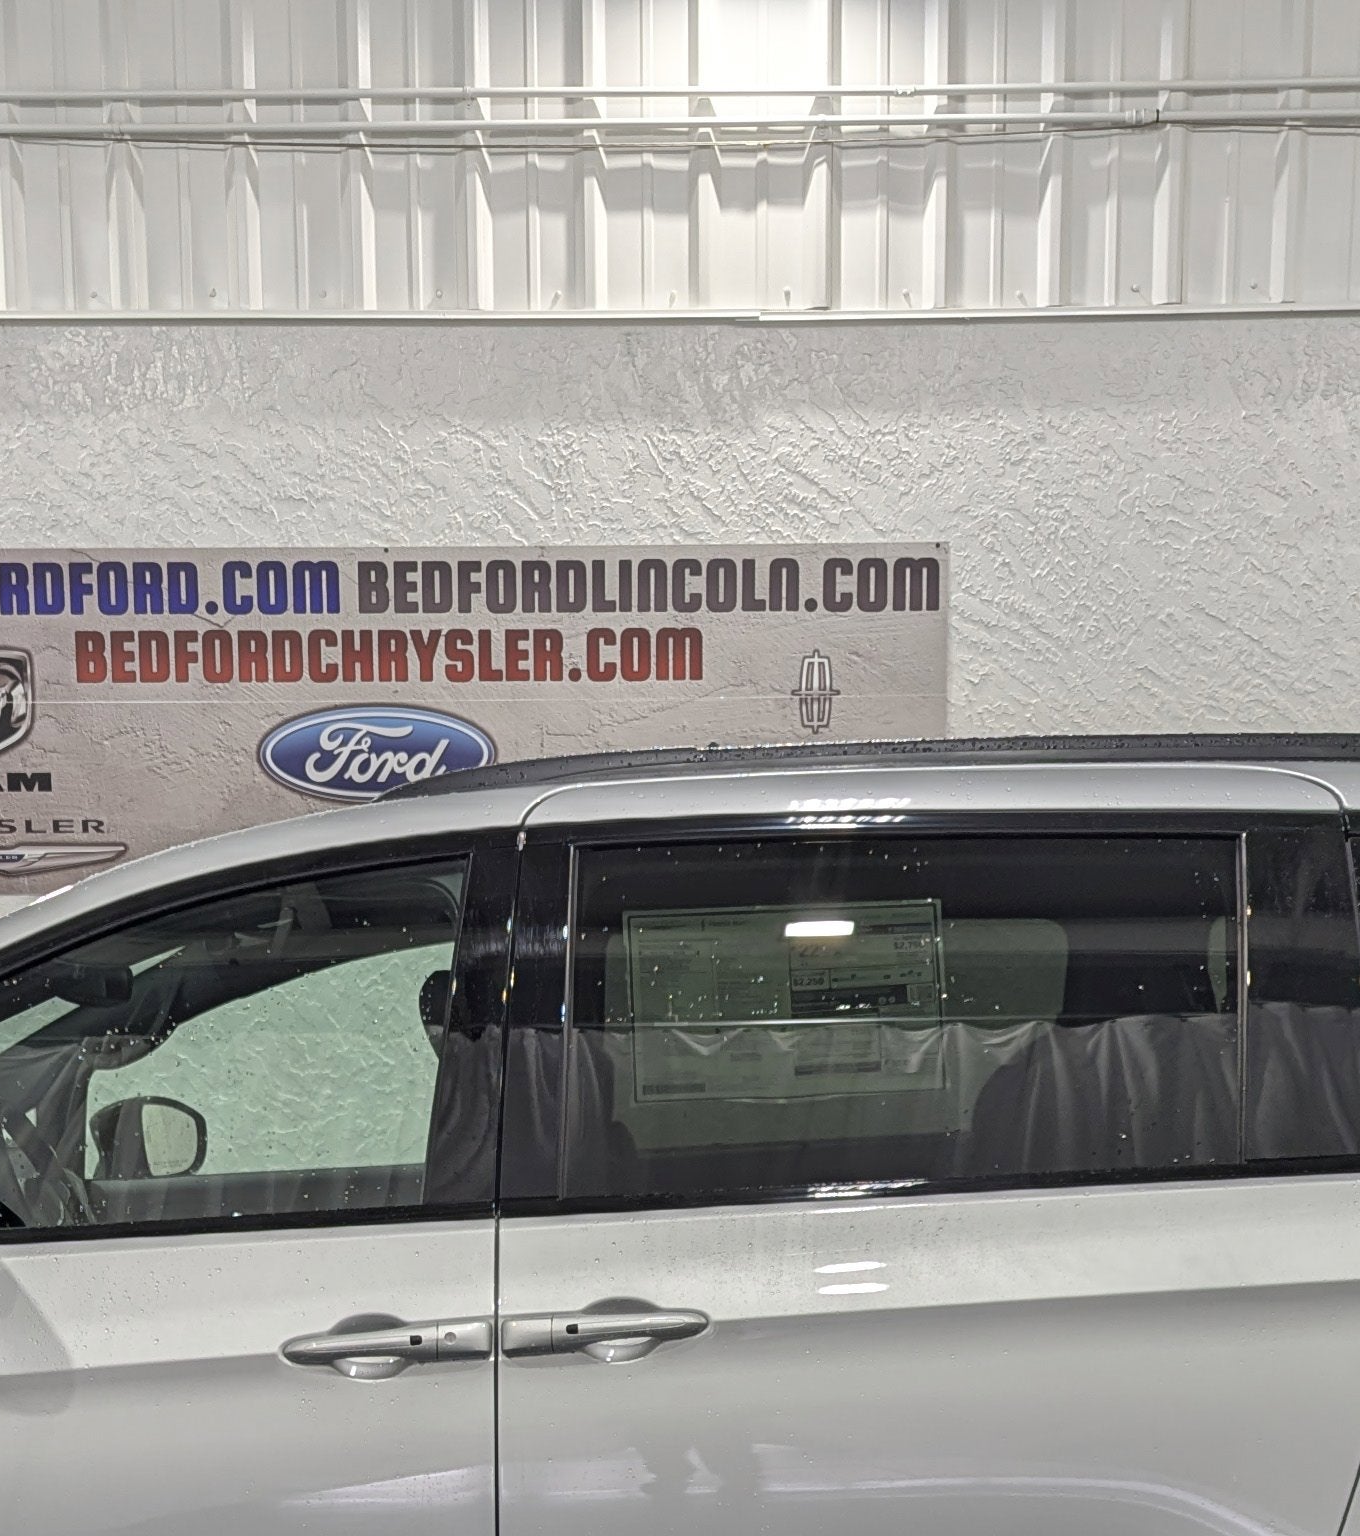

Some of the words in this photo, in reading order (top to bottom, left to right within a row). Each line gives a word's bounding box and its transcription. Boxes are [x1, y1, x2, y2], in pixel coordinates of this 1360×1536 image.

[357, 557, 941, 614] BEDFORDLINCOLN.COM
[74, 627, 703, 684] BEDFORDCHRYSLER.COM
[304, 722, 450, 783] Ford
